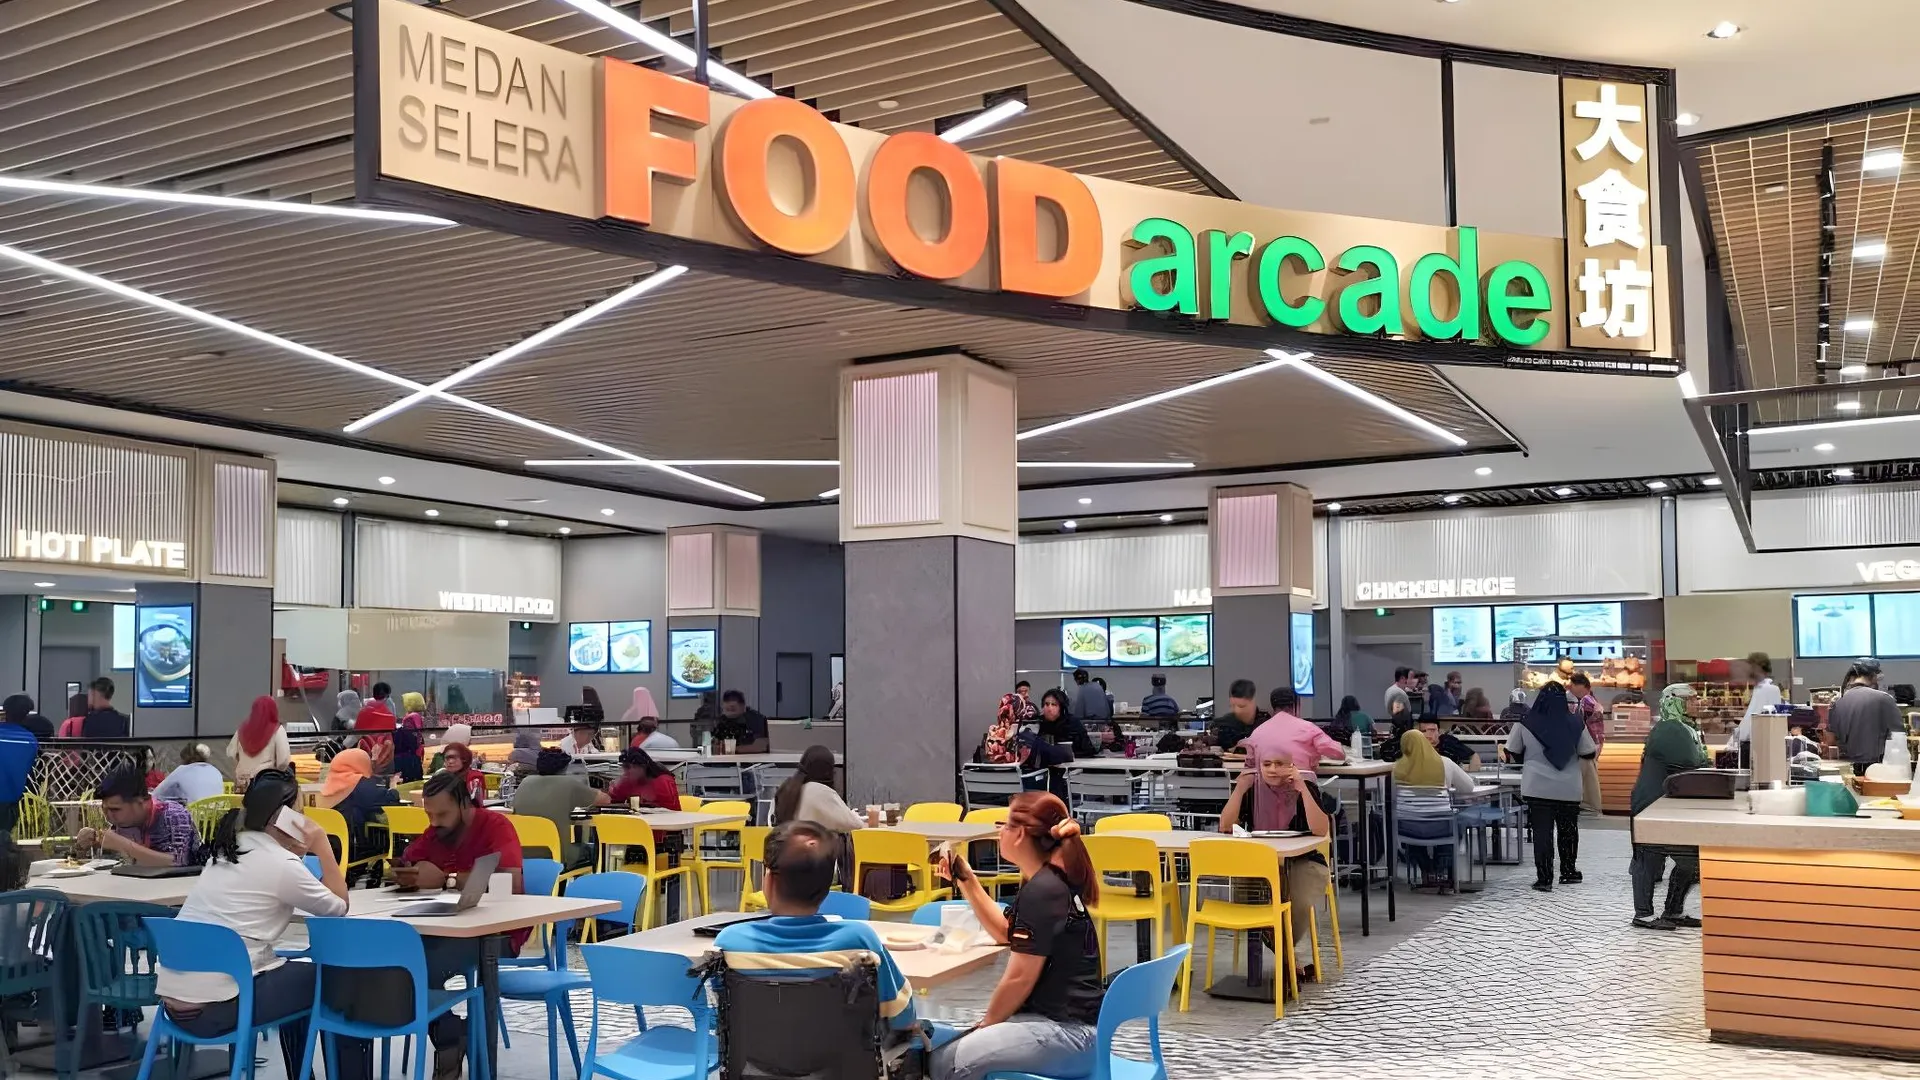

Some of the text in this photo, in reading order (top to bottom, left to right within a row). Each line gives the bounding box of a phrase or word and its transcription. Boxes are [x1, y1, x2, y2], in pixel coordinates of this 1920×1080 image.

[399, 24, 567, 120] MEDAN
[398, 94, 581, 189] SELERA
[603, 55, 1552, 347] FOOD arcade
[1573, 83, 1653, 338] 大食坊
[15, 529, 187, 569] HOT PLATE
[1856, 560, 1920, 582] VEG
[1173, 587, 1212, 607] NAS
[1357, 577, 1516, 600] CHICKEN RICE
